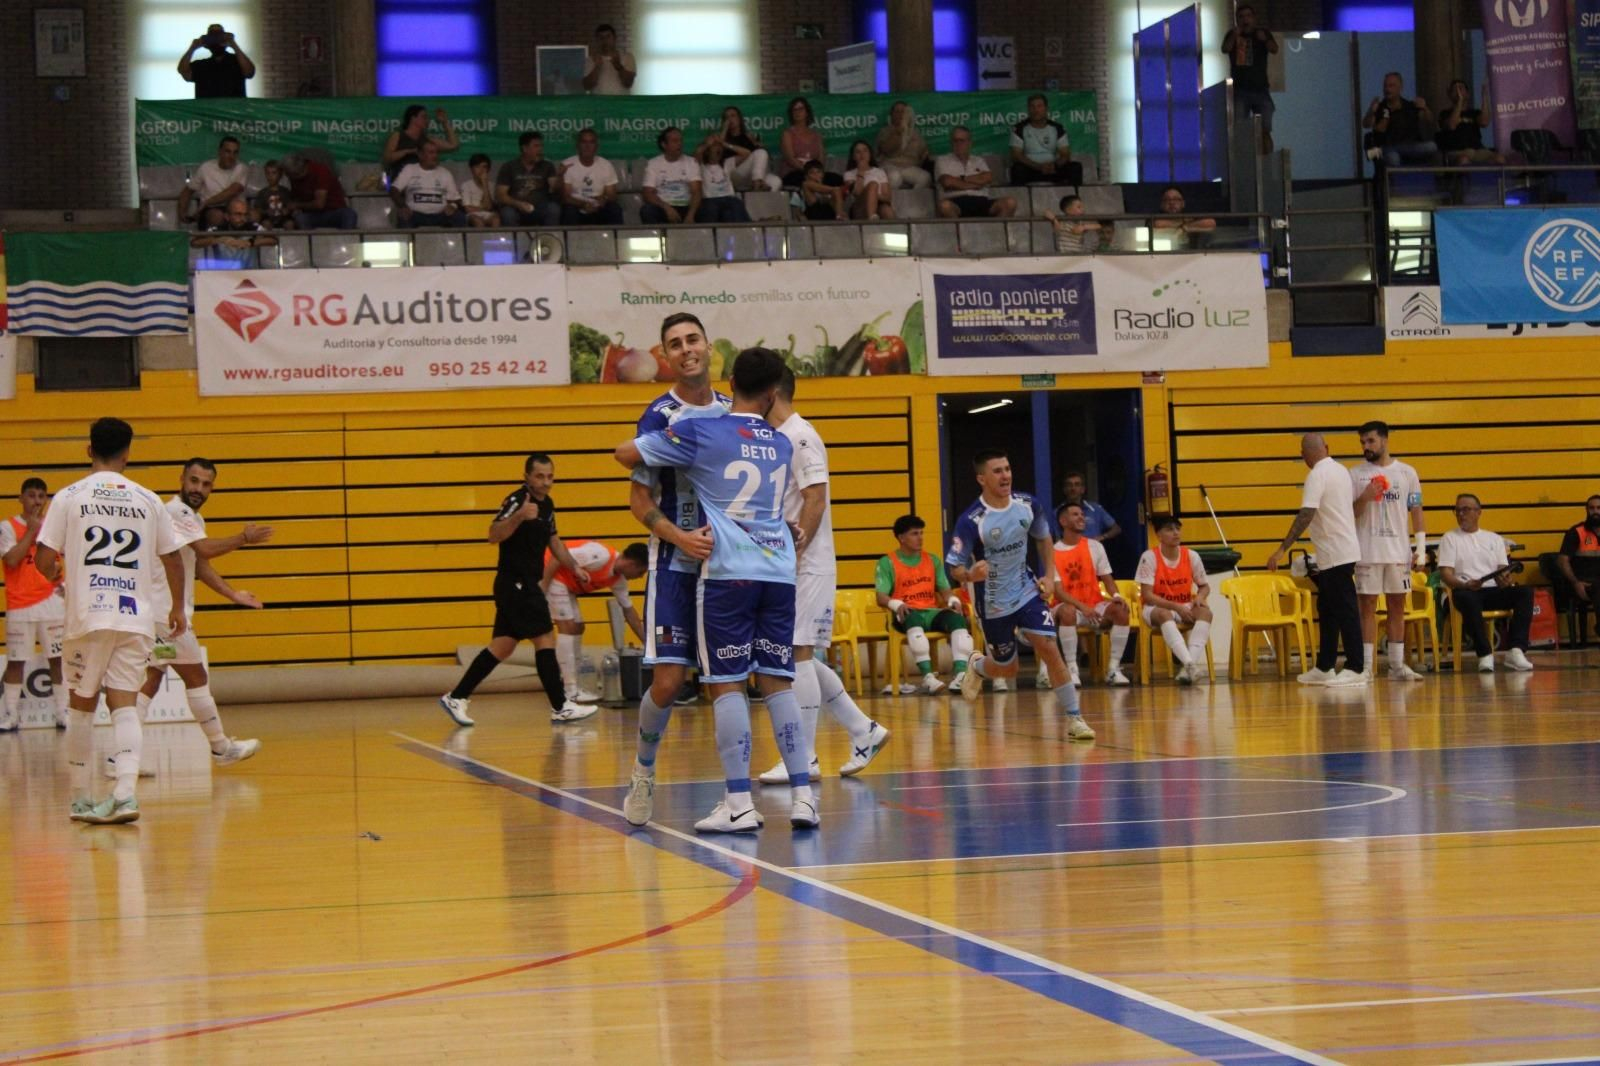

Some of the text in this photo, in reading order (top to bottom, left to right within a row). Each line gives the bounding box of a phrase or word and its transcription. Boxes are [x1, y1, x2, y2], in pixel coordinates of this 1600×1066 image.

[1497, 103, 1515, 113] BIO
[213, 120, 302, 134] INAGROUP
[312, 119, 400, 133] INAGROUP
[508, 118, 595, 131] INAGROUP
[604, 118, 690, 131] INAGROUP
[620, 286, 871, 305] Ramiro Arnedo semillas con futuro
[950, 287, 1078, 317] radio poniente
[1113, 306, 1250, 330] Radio luz
[378, 339, 385, 349] y
[454, 334, 488, 346] desde
[491, 333, 517, 345] 1994
[223, 358, 547, 382] www.rgauditores.eu 950 25 42 42
[740, 443, 777, 461] BETO
[723, 459, 788, 520] 21
[80, 504, 146, 520] JUANFRAN
[84, 525, 141, 569] 22
[89, 573, 136, 591] Zambú
